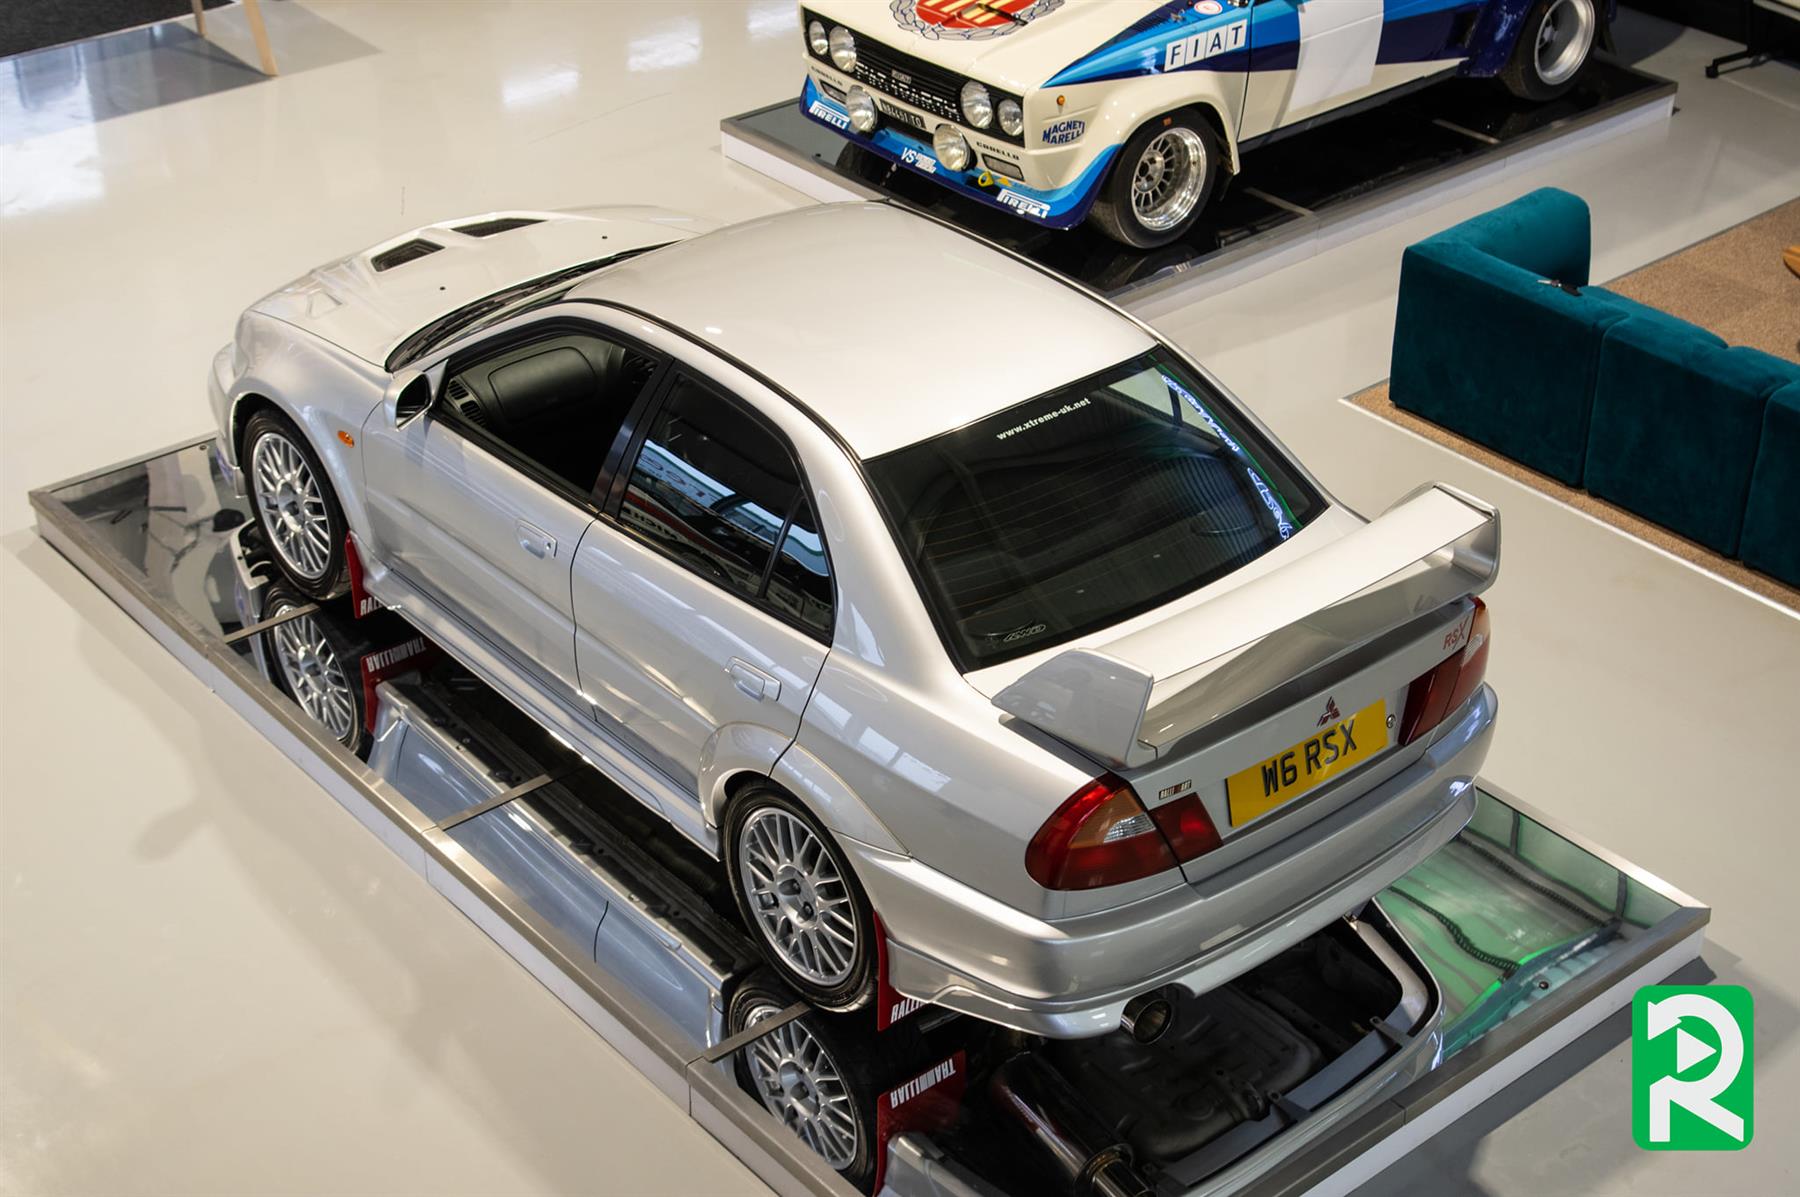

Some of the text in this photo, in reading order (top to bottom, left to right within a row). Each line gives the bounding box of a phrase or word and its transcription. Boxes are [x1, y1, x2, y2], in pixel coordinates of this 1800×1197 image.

[1170, 26, 1244, 66] FIAT
[809, 100, 850, 129] PIRELLI
[1042, 120, 1085, 141] MAGNETI
[901, 147, 917, 163] VS
[996, 188, 1051, 219] PIRELLI
[996, 397, 1091, 441] www.xtreme-uk.net
[1443, 615, 1469, 650] RSX
[1261, 719, 1357, 797] W6 RSX
